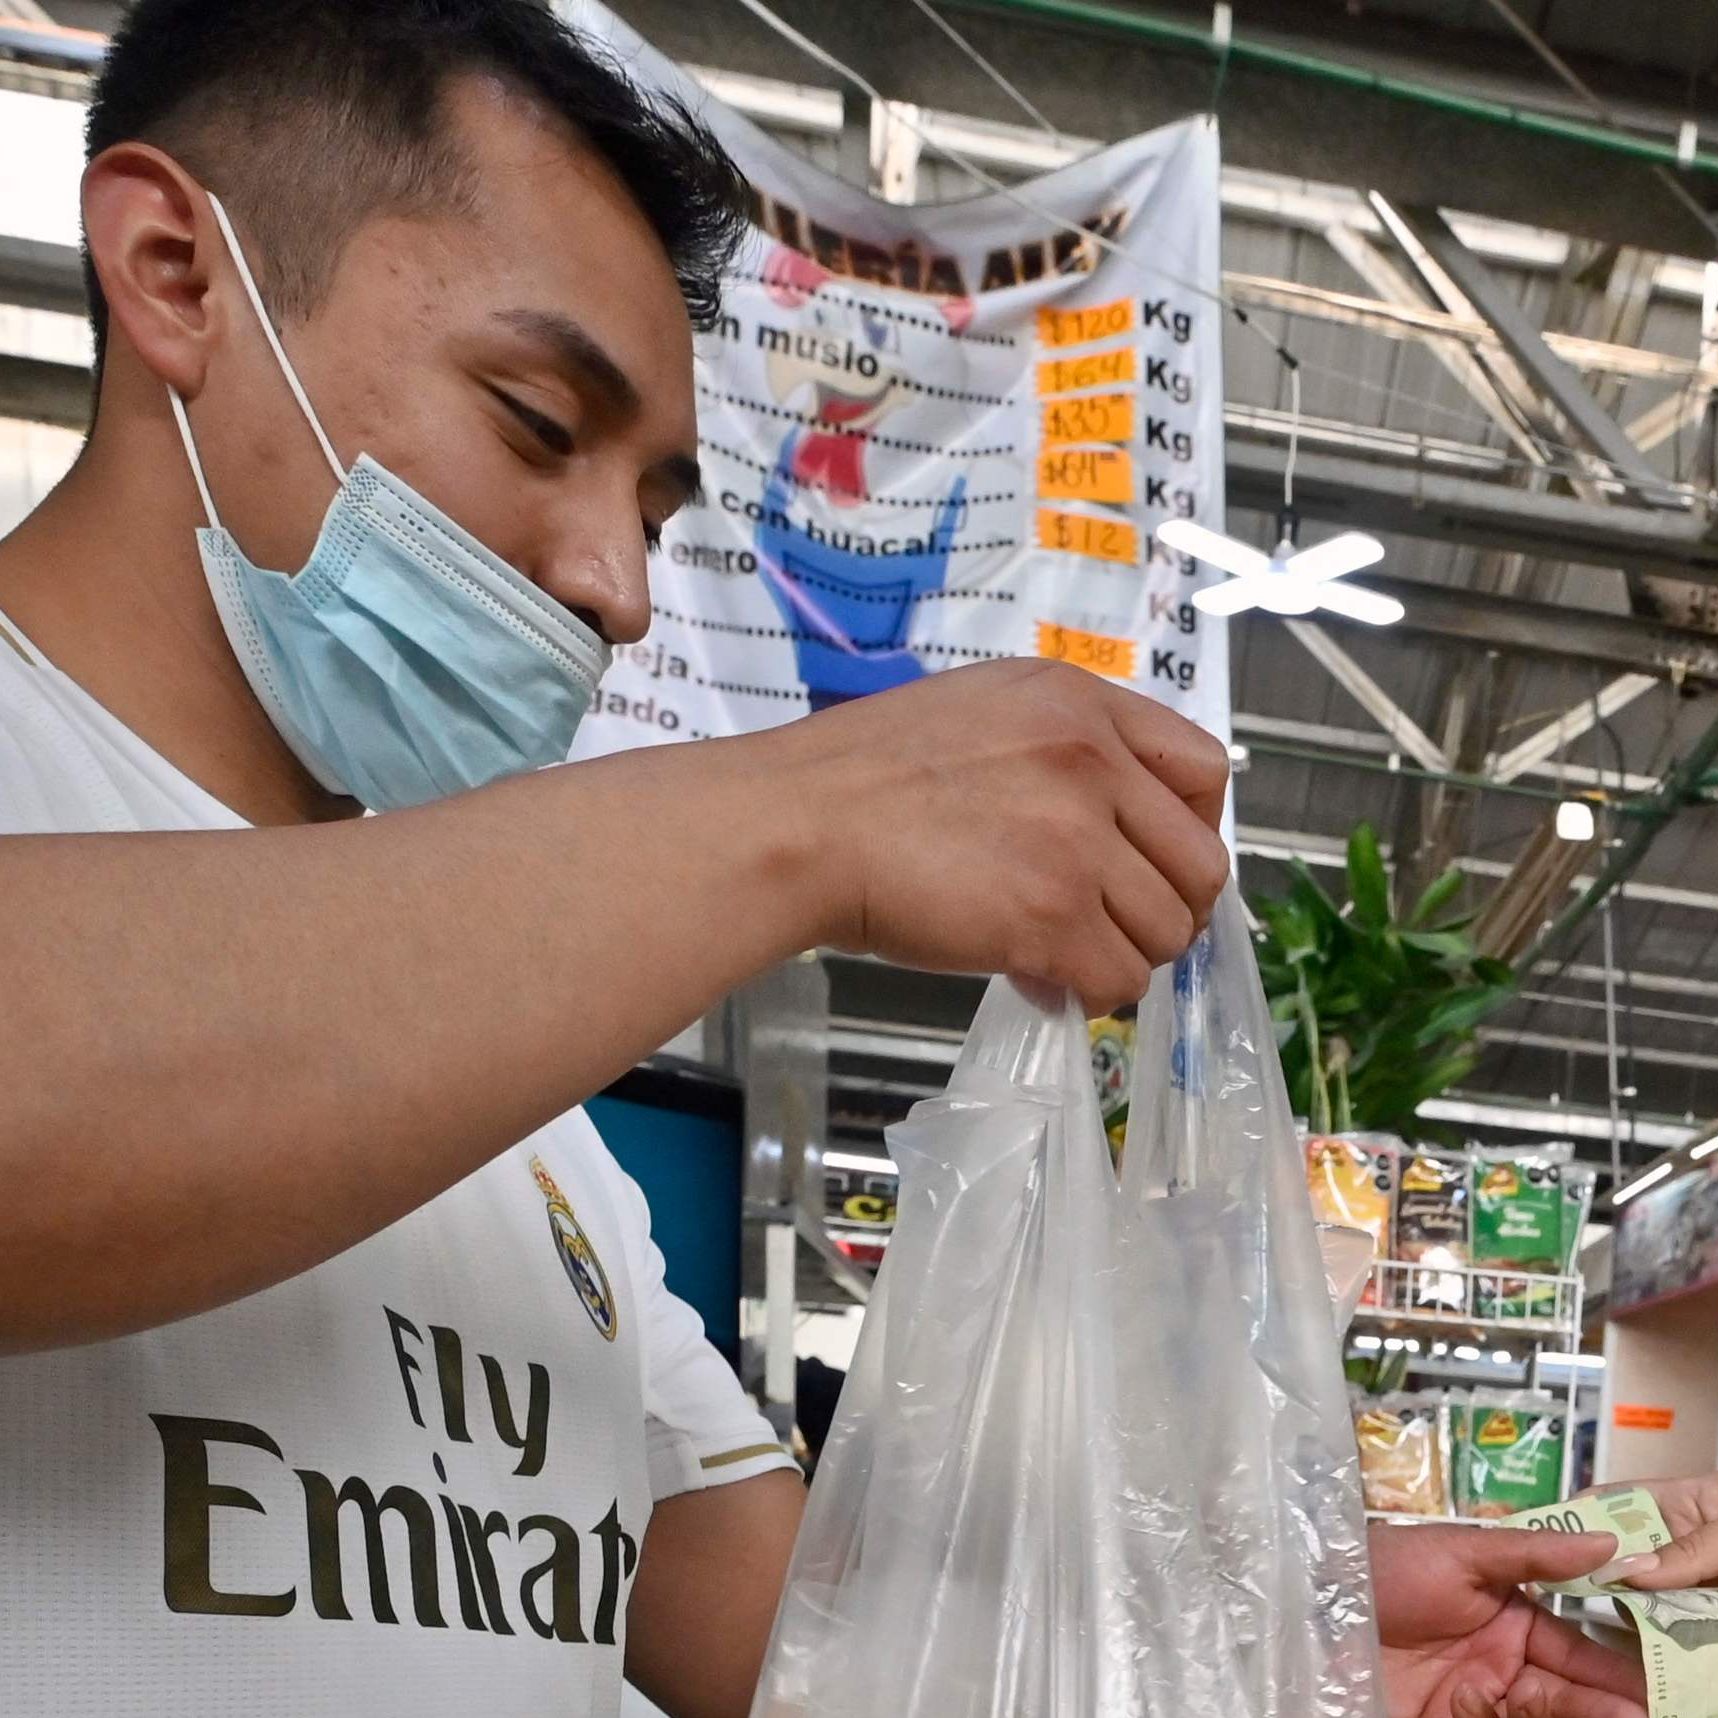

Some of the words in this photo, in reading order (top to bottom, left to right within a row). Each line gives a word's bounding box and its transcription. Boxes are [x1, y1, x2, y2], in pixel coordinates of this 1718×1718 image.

[1144, 300, 1193, 344] Kg
[1146, 357, 1193, 403] Kg
[1147, 416, 1193, 462] Kg
[1147, 476, 1196, 519] Kg
[720, 490, 791, 530] con
[806, 518, 937, 559] huacal
[1150, 593, 1197, 635] Kg
[1152, 649, 1196, 691] Kg
[383, 1304, 551, 1477] Fly
